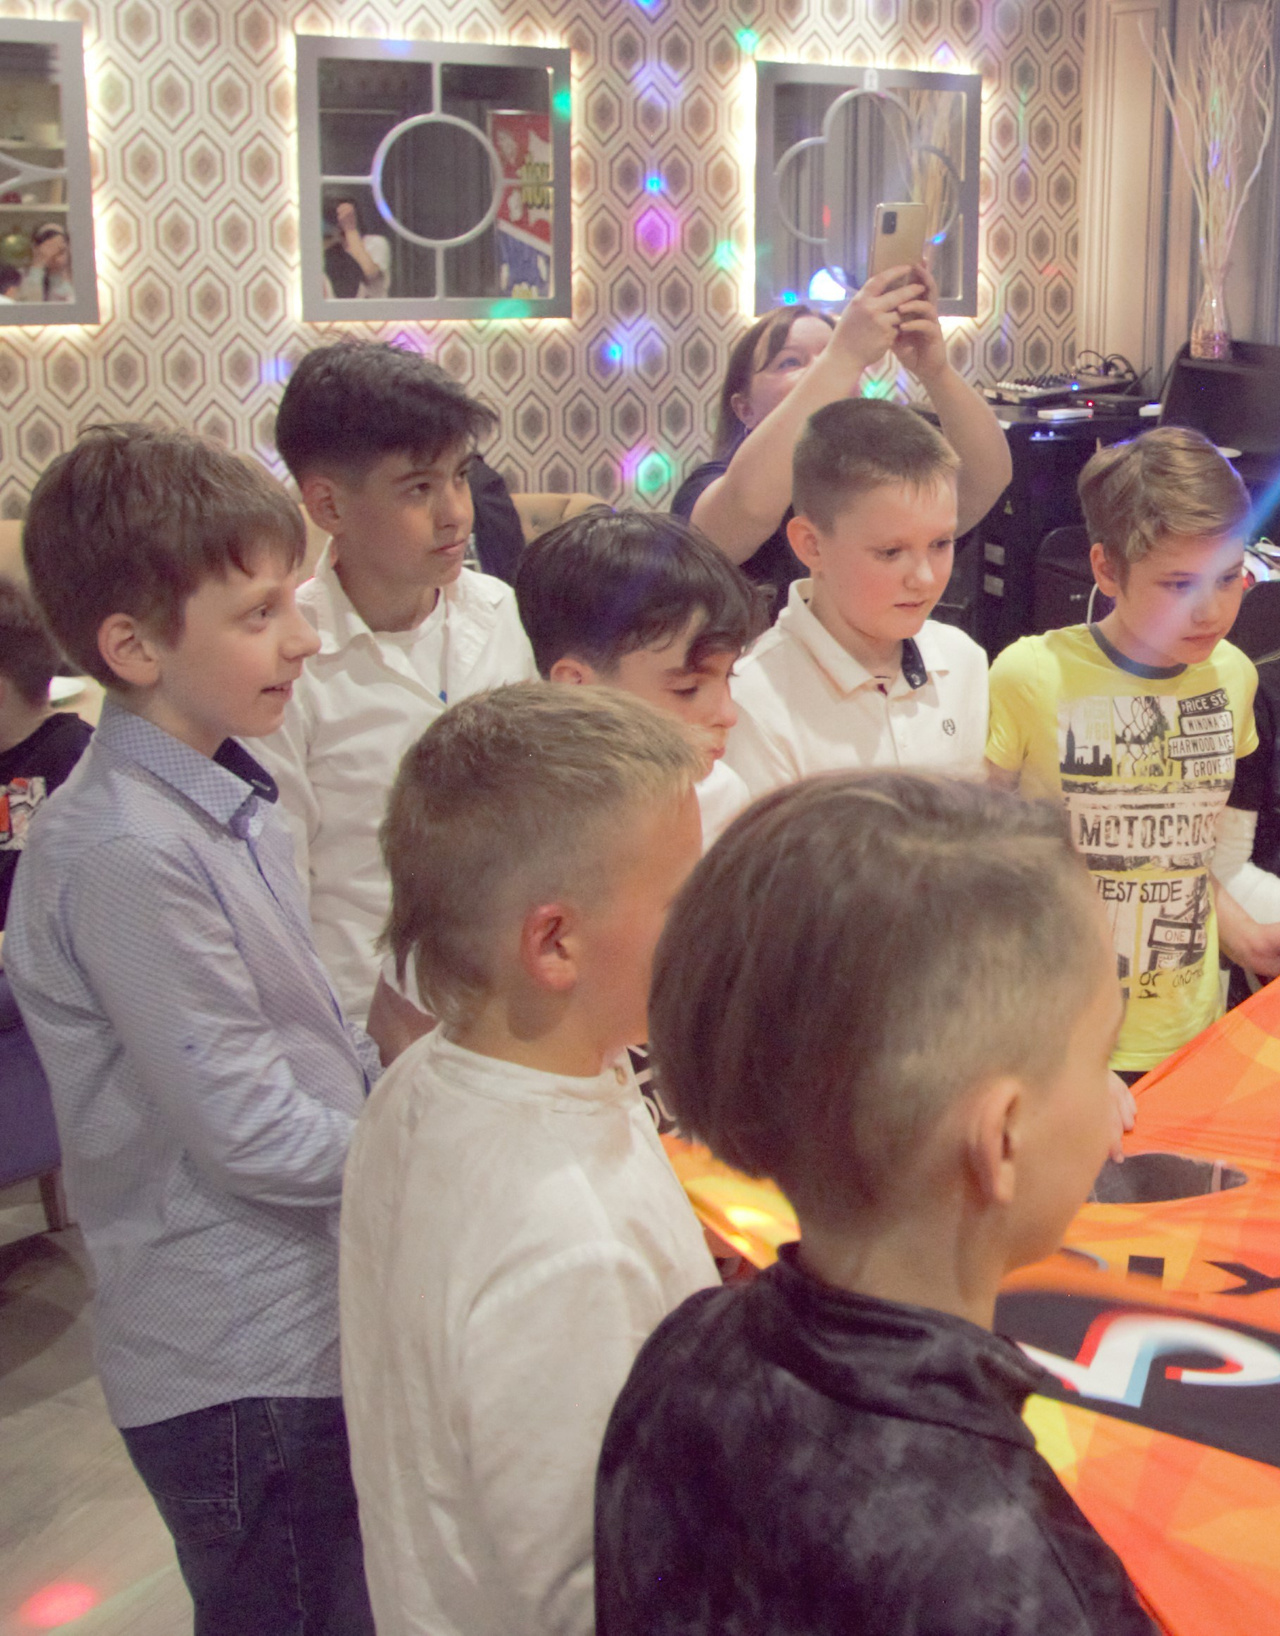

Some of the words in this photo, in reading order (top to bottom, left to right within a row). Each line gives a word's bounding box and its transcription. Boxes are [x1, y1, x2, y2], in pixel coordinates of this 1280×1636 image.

[1172, 736, 1216, 756] HARWOOD
[1193, 758, 1222, 778] GROVE
[1097, 877, 1138, 903] EST
[1139, 879, 1184, 903] SIDE
[1164, 929, 1186, 943] ONE
